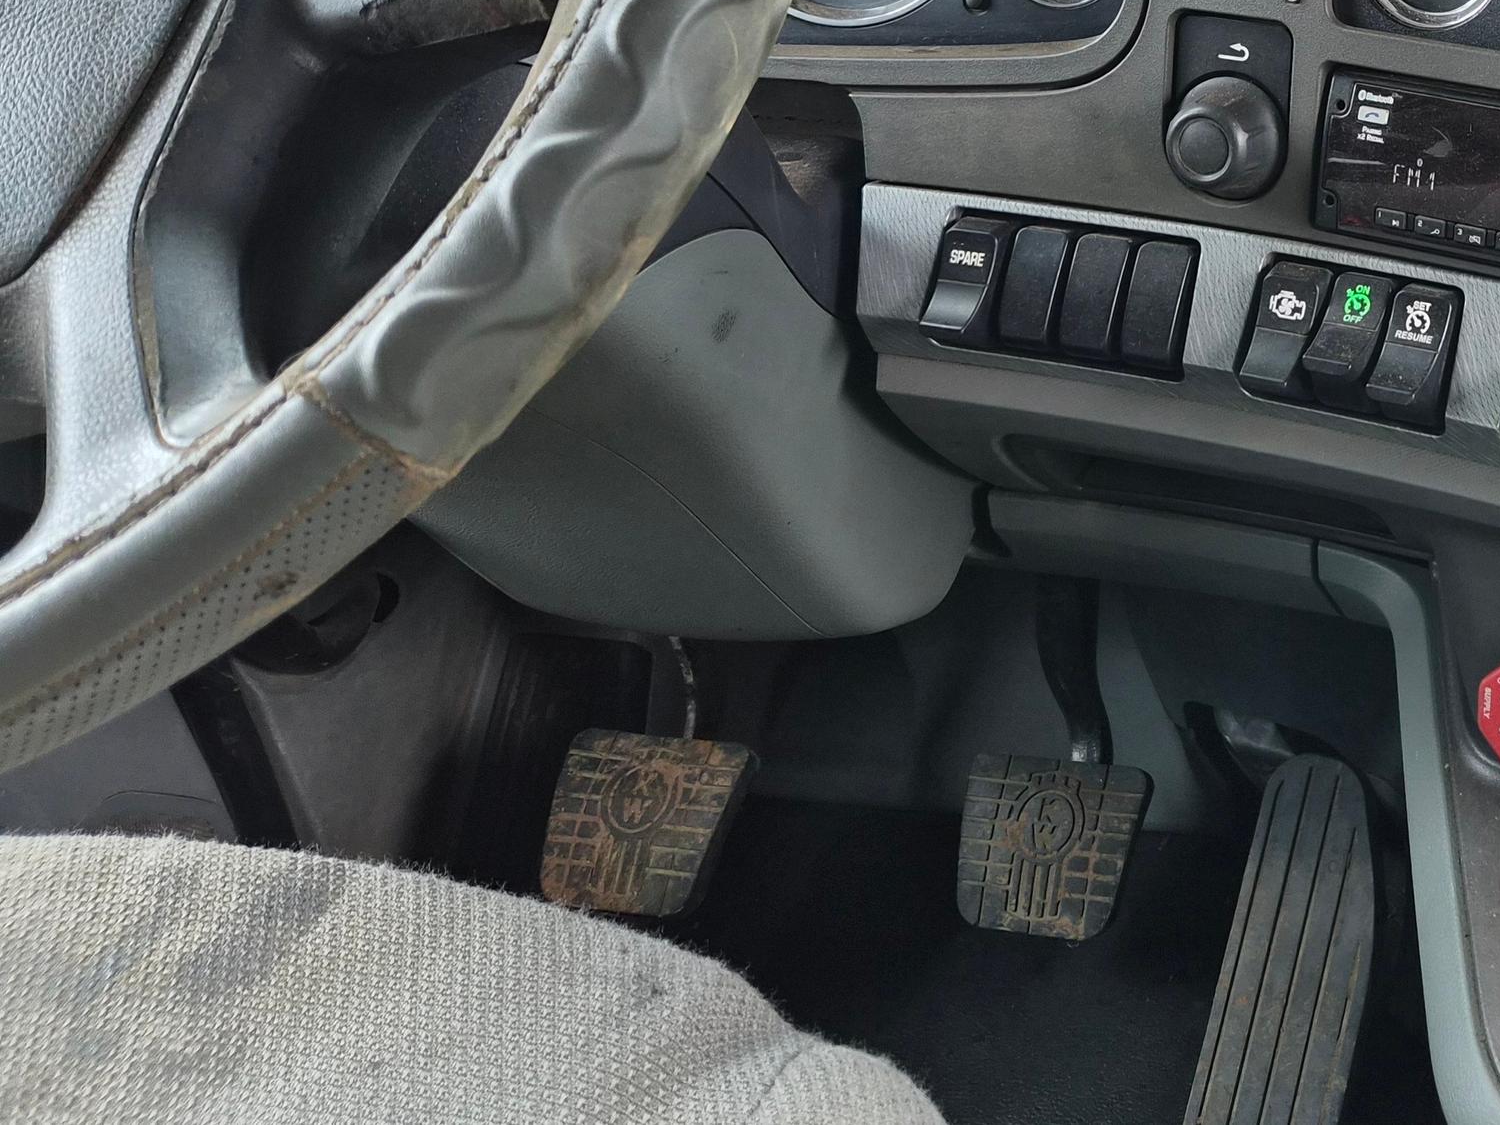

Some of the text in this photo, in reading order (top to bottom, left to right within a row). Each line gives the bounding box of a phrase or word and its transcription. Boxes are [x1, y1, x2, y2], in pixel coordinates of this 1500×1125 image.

[1457, 228, 1463, 236] 3
[950, 249, 986, 268] SPARE
[1356, 284, 1371, 295] ON
[1412, 300, 1432, 312] SET
[1343, 315, 1363, 324] OFF
[1394, 329, 1433, 344] RESUME
[1483, 687, 1491, 719] SUPPLY
